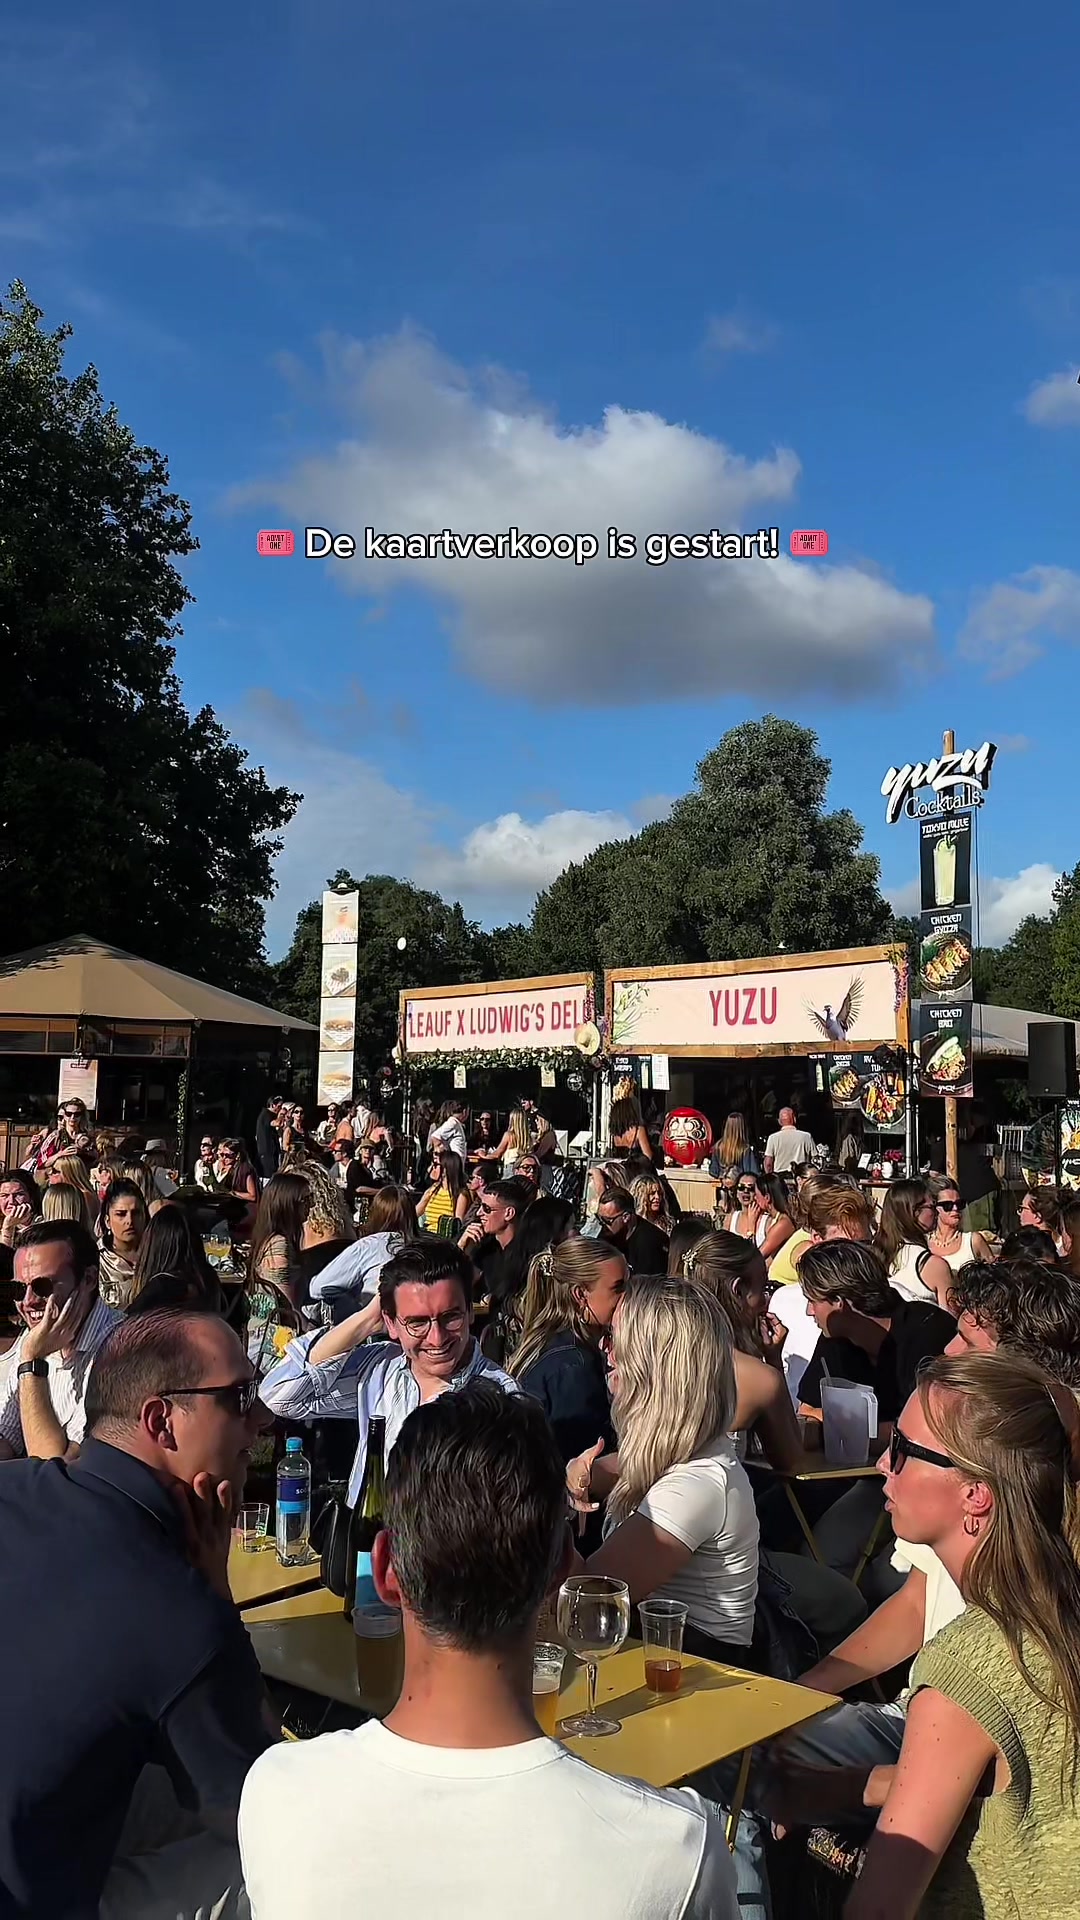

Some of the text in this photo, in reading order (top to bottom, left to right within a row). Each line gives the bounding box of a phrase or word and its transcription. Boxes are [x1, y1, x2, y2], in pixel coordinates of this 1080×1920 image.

[904, 784, 981, 819] Cocktails
[921, 821, 947, 835] TOKYO
[947, 817, 970, 830] MULE
[930, 913, 962, 925] CHICKEN
[709, 986, 777, 1026] YUZU
[929, 1008, 963, 1018] CHICKEN
[410, 1010, 452, 1038] LEAUF
[457, 1009, 465, 1036] X
[470, 1002, 545, 1035] LUDWIG'S
